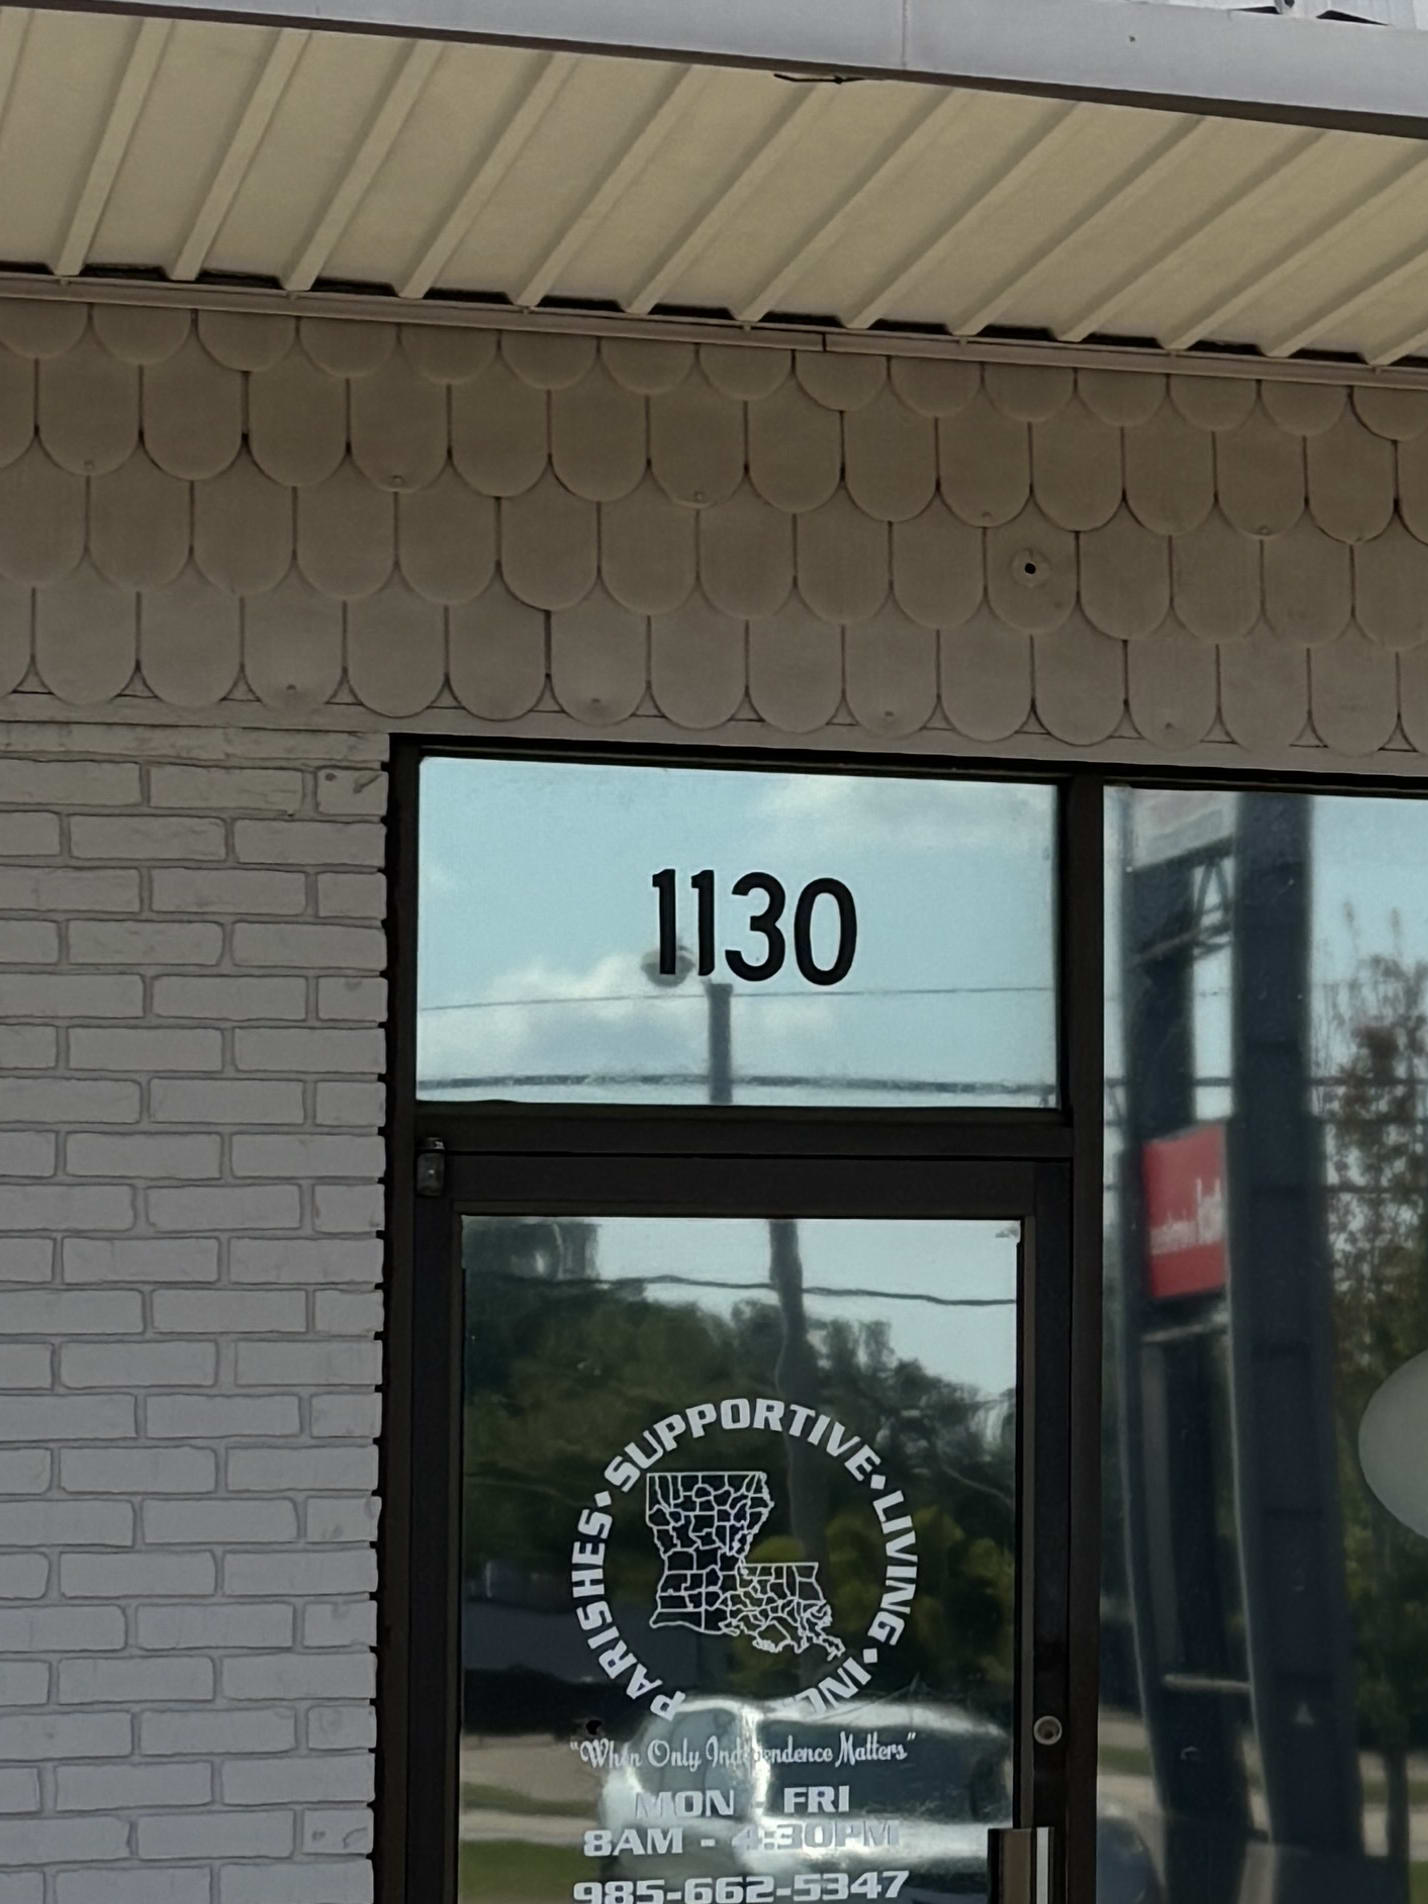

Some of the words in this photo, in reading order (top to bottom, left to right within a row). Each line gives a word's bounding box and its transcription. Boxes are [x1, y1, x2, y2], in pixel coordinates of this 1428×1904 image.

[651, 867, 858, 987] 1130
[604, 1397, 883, 1494] SUPPORTIVE
[571, 1507, 686, 1721] PARISHES
[872, 1489, 918, 1646] LIVING
[635, 1789, 734, 1818] MON
[784, 1785, 849, 1813] FRI
[648, 1739, 700, 1772] Only
[583, 1827, 683, 1857] 8AM
[731, 1819, 900, 1851] 4:30PM
